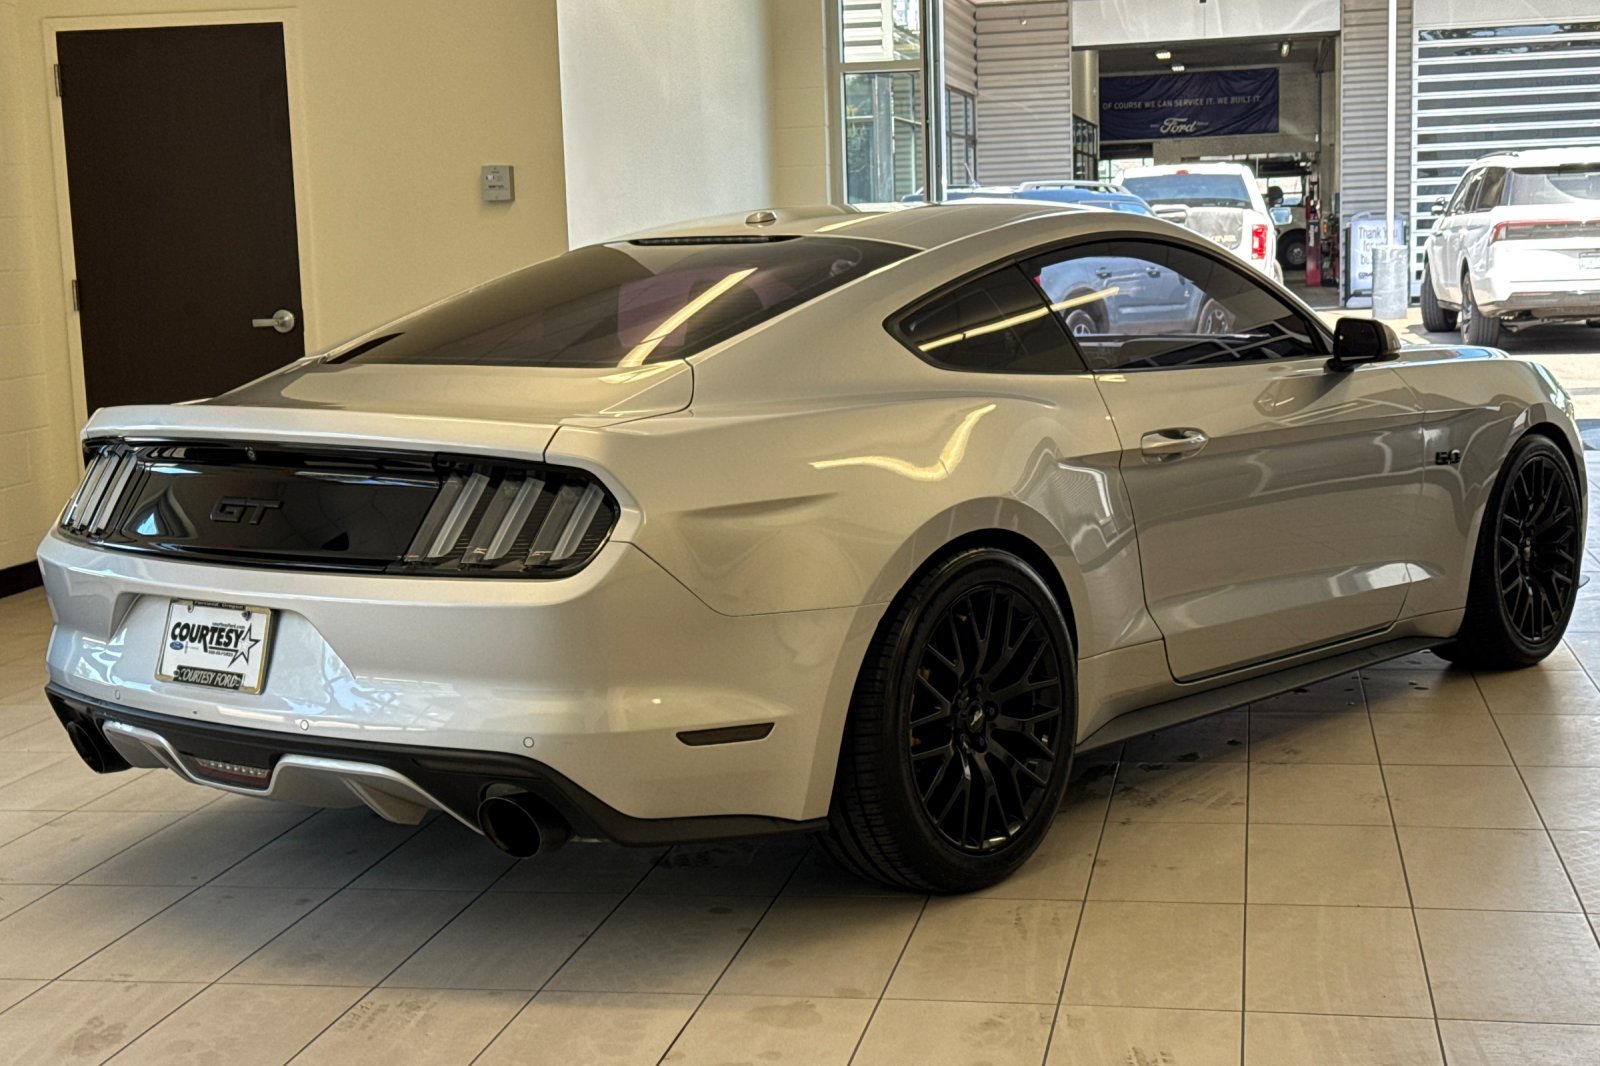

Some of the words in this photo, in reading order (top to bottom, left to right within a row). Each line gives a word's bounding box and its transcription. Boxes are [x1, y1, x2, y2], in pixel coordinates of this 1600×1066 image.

[1103, 102, 1113, 110] OF
[1114, 101, 1142, 110] COURSE
[1144, 100, 1156, 109] WE
[1157, 100, 1173, 108] CAN
[1174, 98, 1204, 107] SERVICE
[1217, 97, 1228, 105] WE
[1230, 96, 1250, 104] BUILT
[1160, 117, 1197, 133] Ford
[1359, 226, 1381, 239] Thank
[210, 496, 284, 525] GT
[171, 621, 244, 653] COURTESY
[178, 668, 214, 684] COURTESY
[214, 673, 239, 687] FORD
